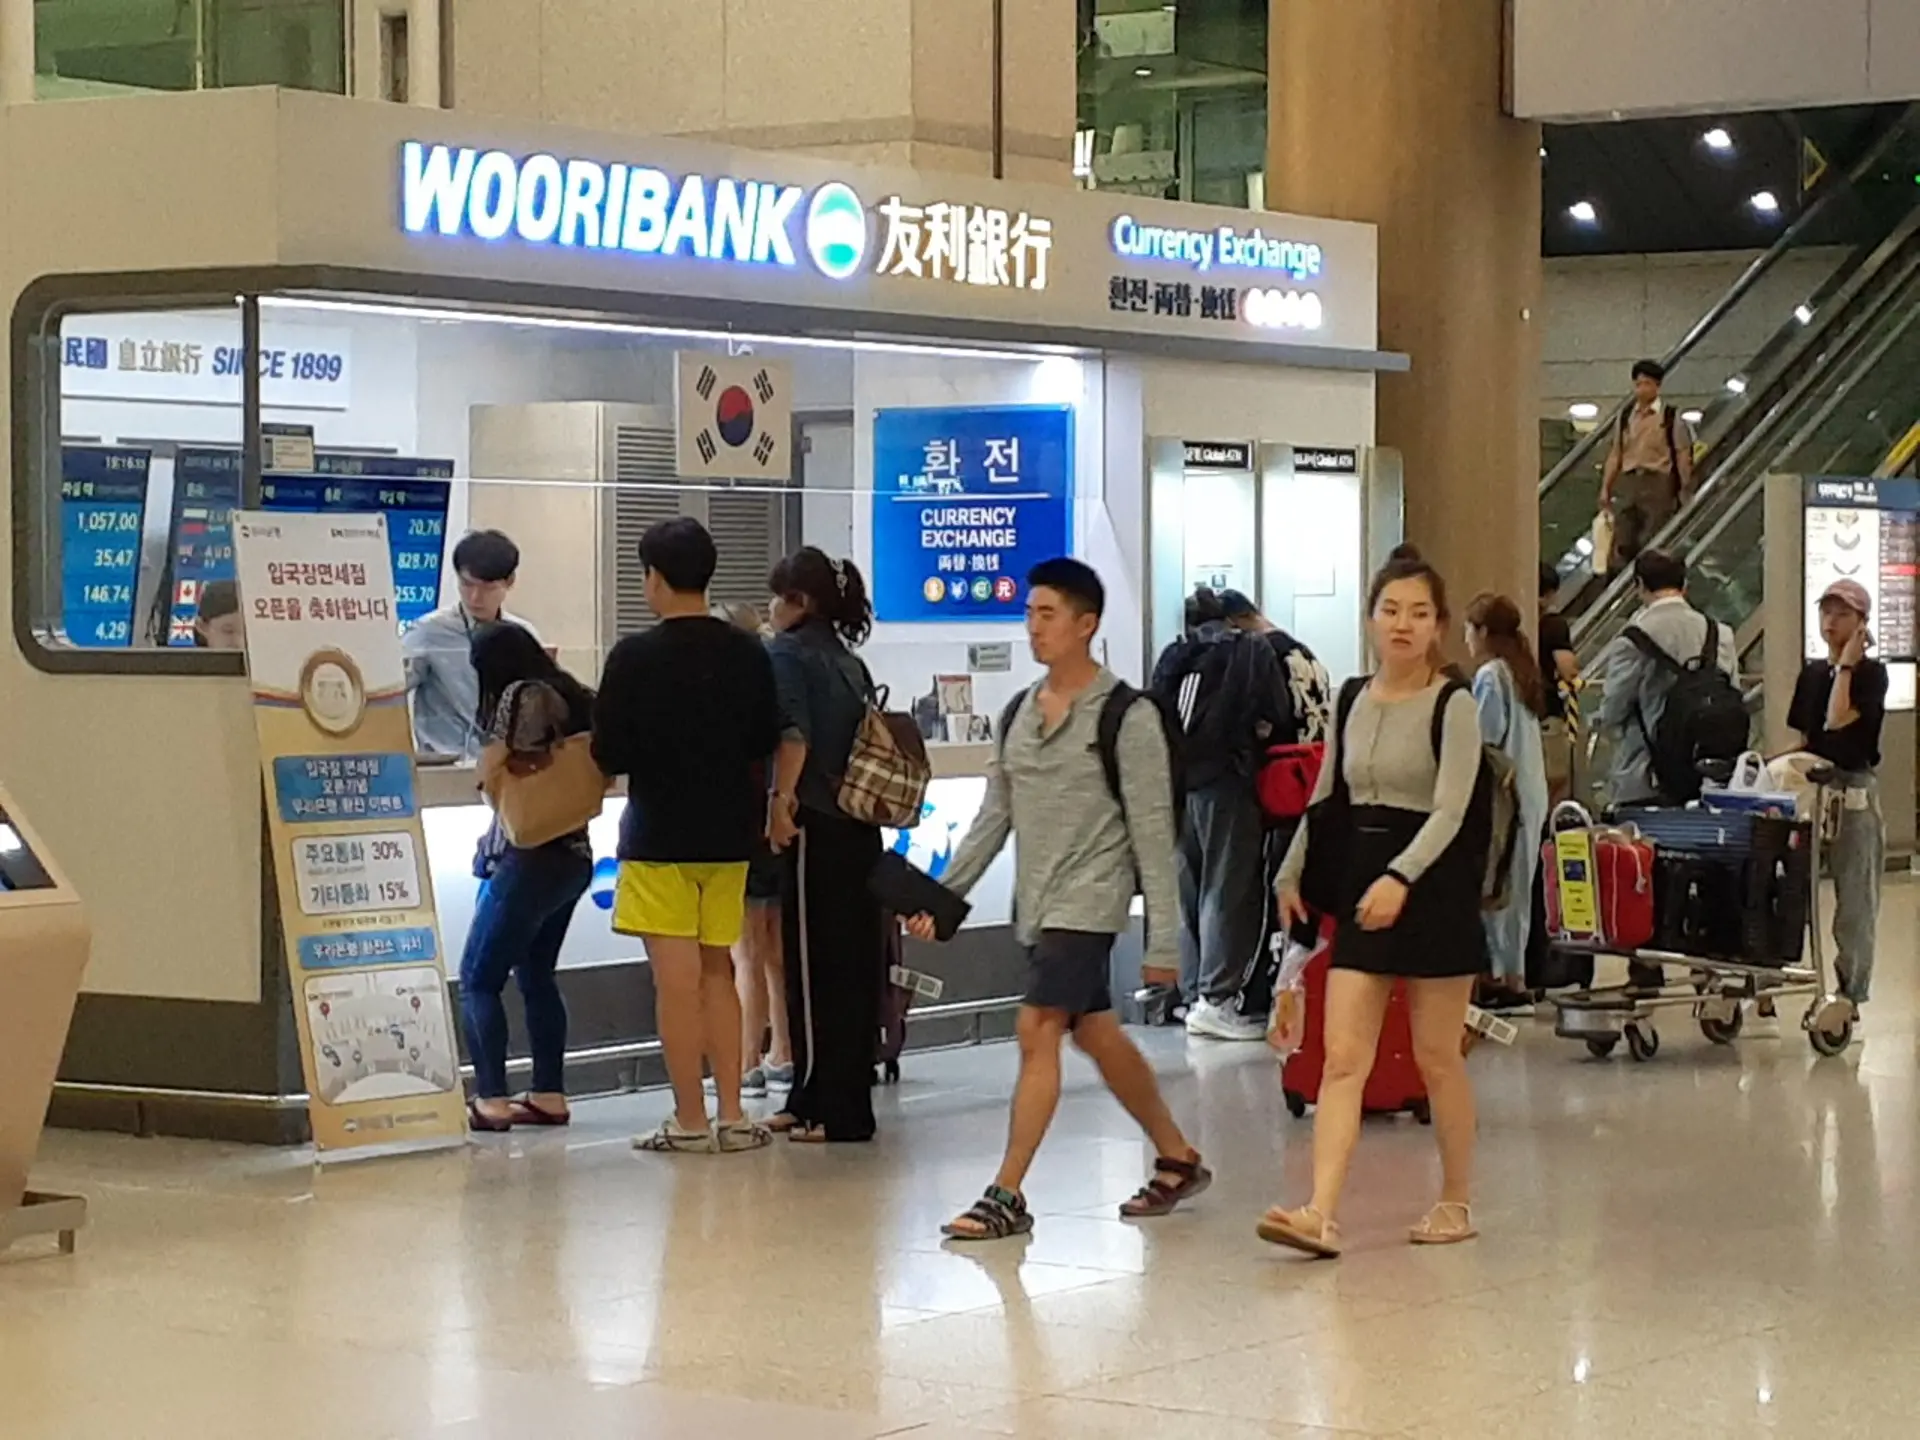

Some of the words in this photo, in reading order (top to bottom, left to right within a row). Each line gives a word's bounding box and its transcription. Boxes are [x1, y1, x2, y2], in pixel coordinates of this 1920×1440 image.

[402, 140, 802, 265] WOORIBANK
[876, 195, 1053, 290] 友利銀行
[1113, 214, 1214, 272] Currency
[1219, 226, 1322, 281] Exchange
[292, 352, 343, 382] 1899
[920, 506, 1017, 527] CURRENCY
[920, 528, 1017, 549] EXCHANGE
[267, 561, 366, 586] 입국장면세점
[253, 598, 302, 621] 오픈을
[308, 596, 389, 621] 축하합니다
[95, 621, 126, 640] 4.29
[371, 840, 405, 861] 30%
[377, 880, 409, 902] 15%
